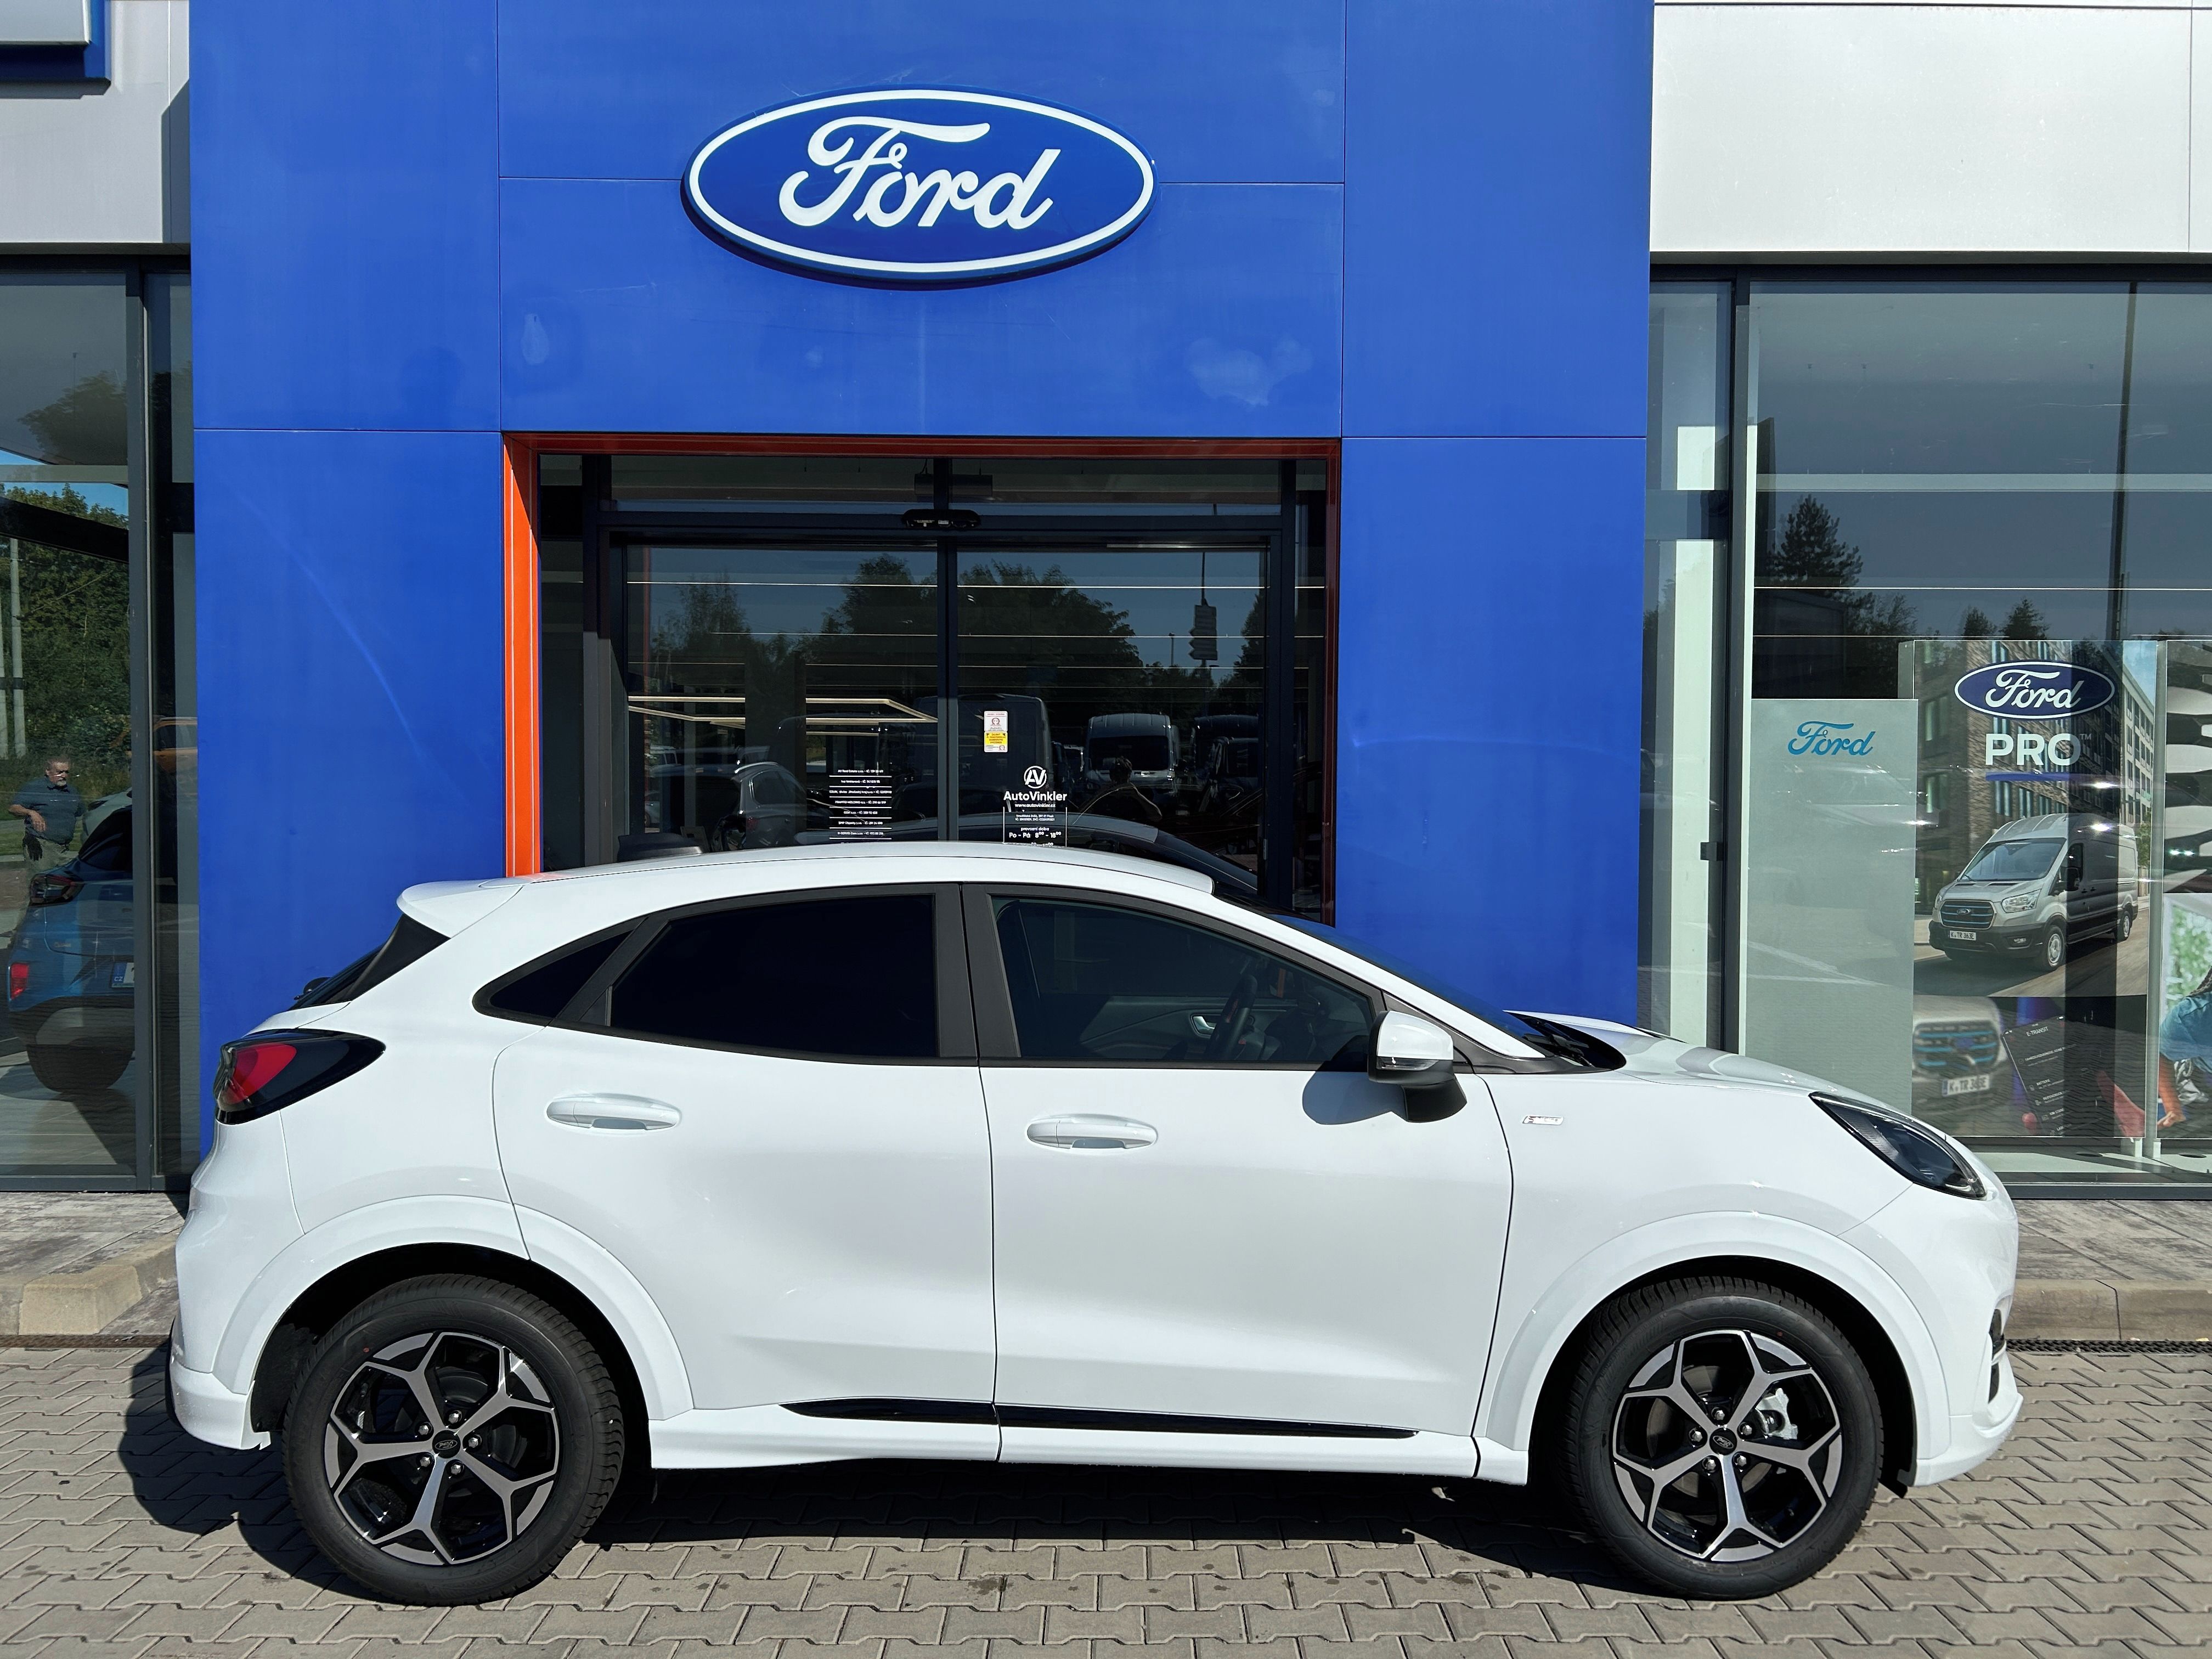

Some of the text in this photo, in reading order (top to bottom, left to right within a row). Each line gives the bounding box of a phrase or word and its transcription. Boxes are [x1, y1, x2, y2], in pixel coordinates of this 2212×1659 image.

[779, 116, 1061, 230] Ford
[1985, 669, 2085, 709] Ford
[1787, 721, 1876, 755] Ford
[1985, 733, 2081, 766] PRO
[1024, 769, 1047, 785] AV
[1003, 791, 1068, 801] AutoVinkler
[2026, 1026, 2049, 1037] E-TRANSIT
